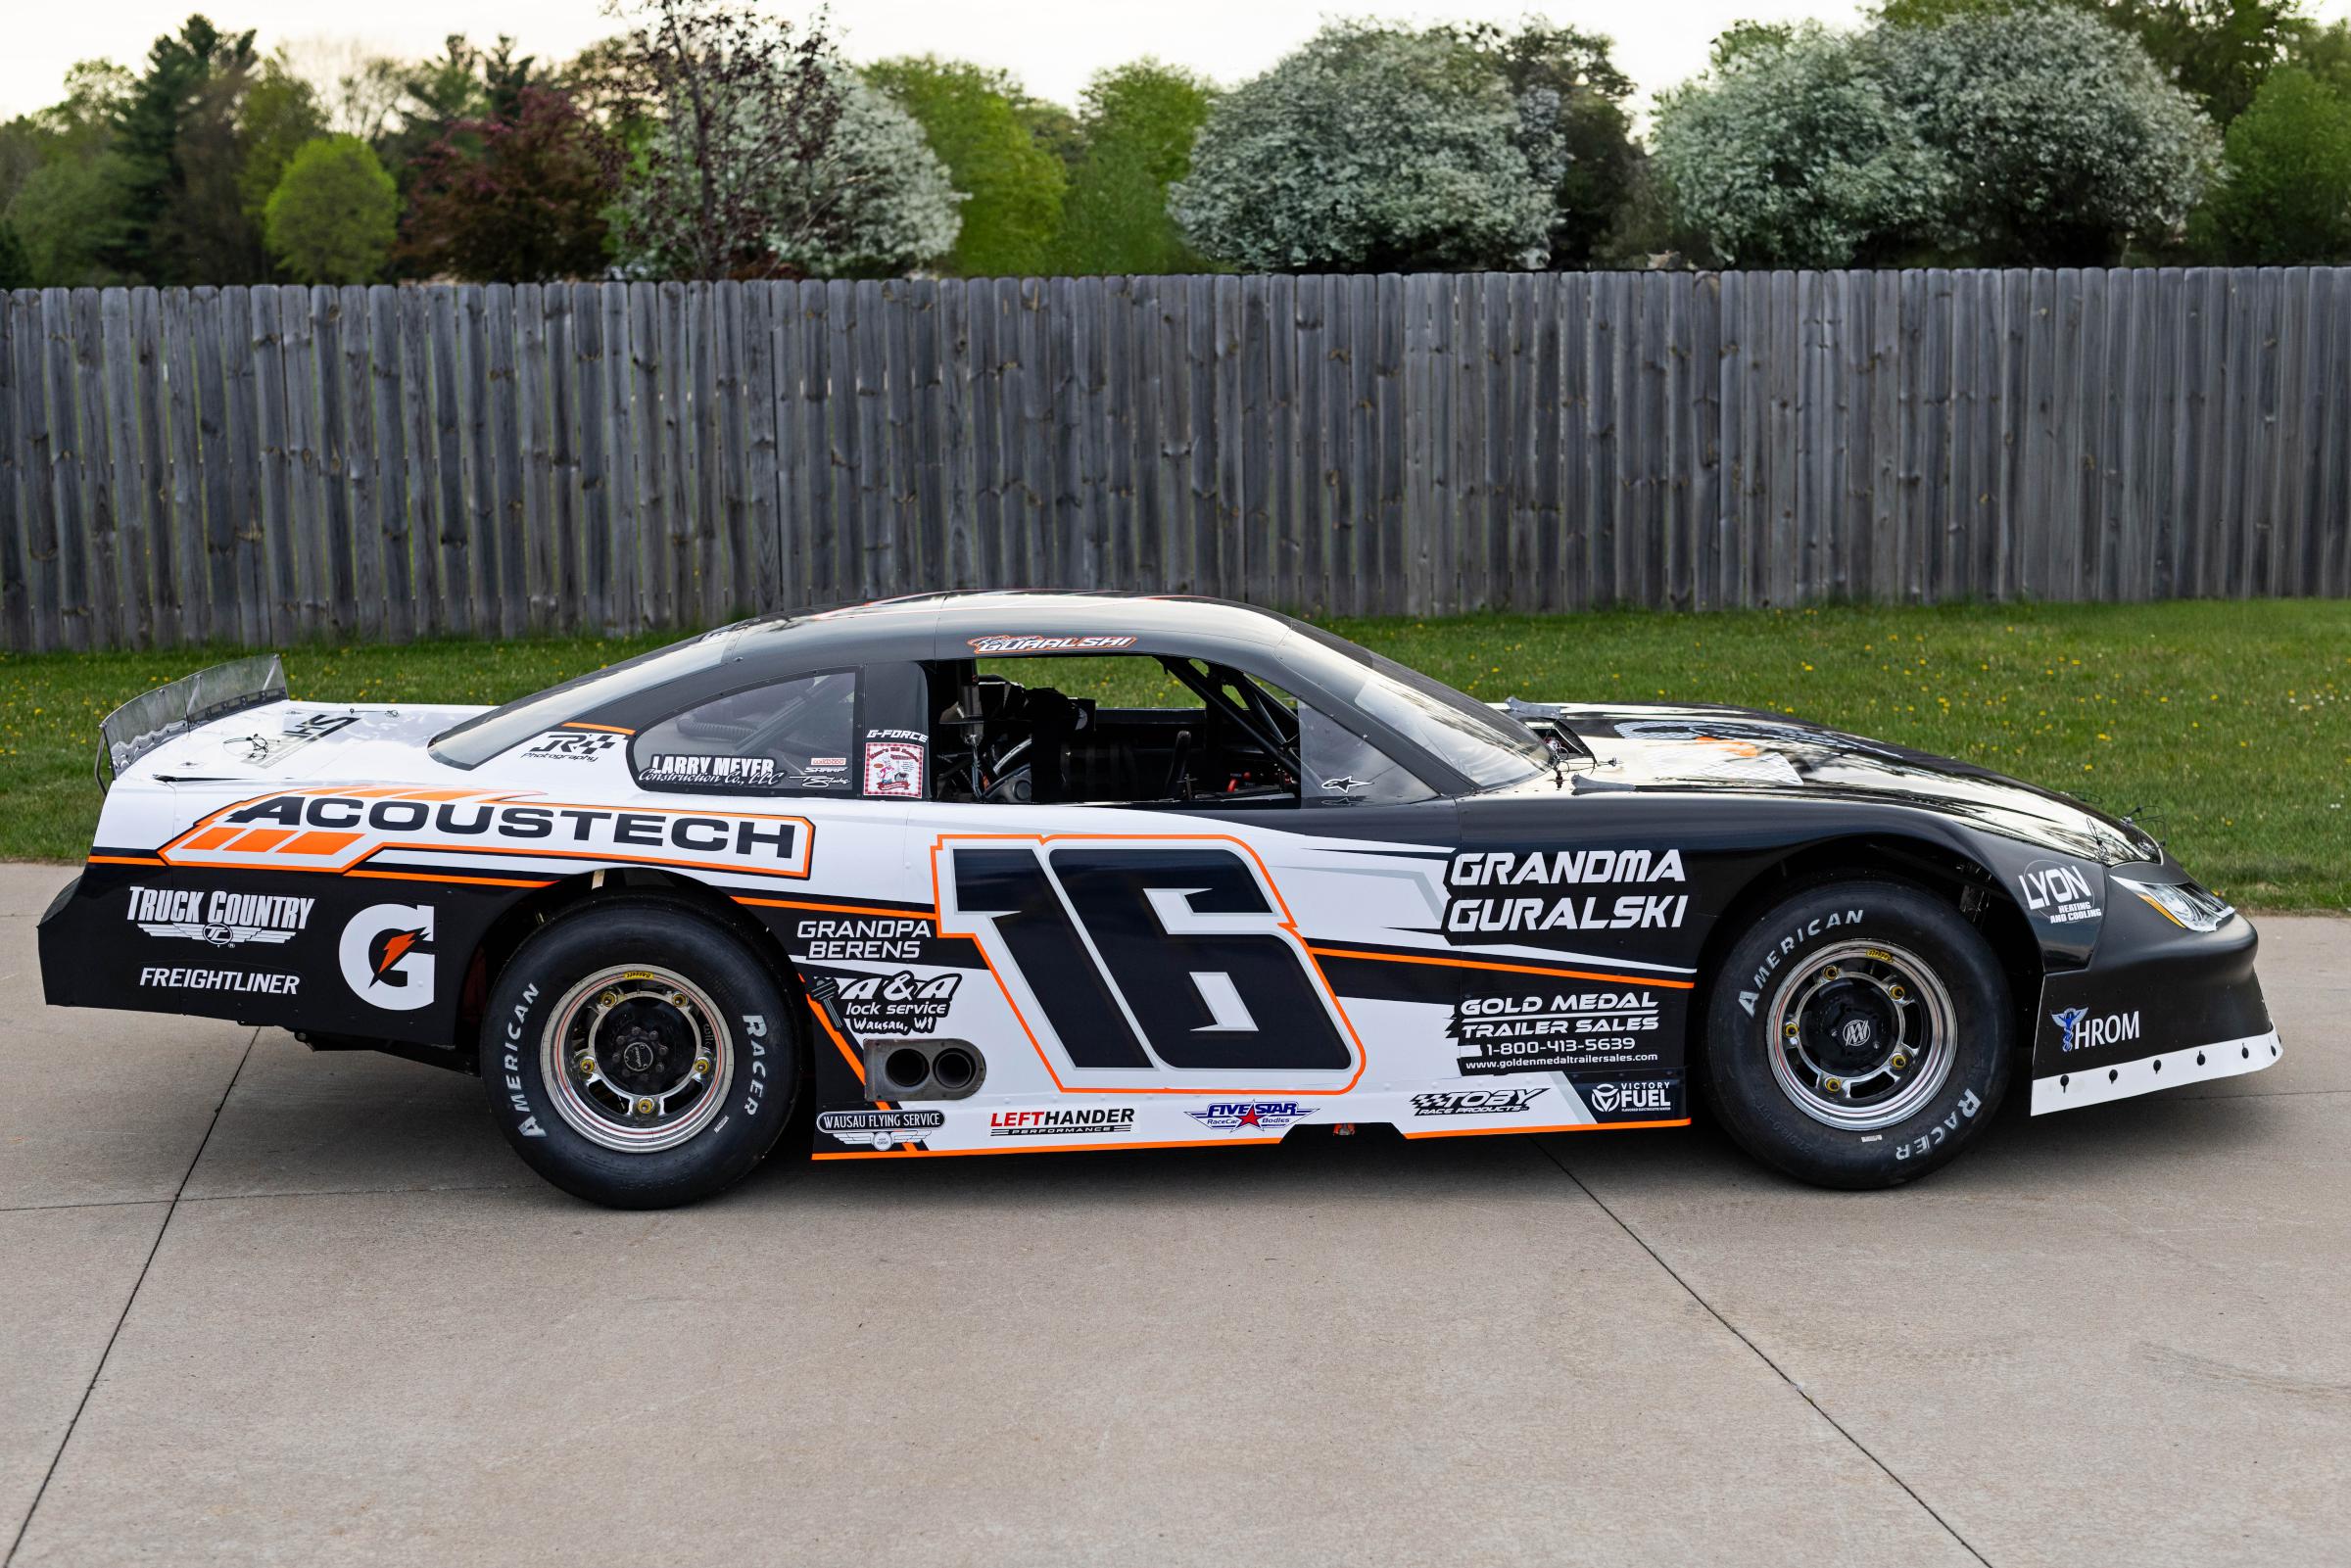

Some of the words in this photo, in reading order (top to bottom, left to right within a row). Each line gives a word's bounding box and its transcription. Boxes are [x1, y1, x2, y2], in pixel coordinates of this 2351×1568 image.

[866, 729, 929, 742] G-FORCE
[520, 752, 599, 762] Photography
[652, 755, 711, 775] LARRY
[713, 757, 774, 778] MEYER
[639, 768, 721, 783] Construction
[748, 772, 784, 785] LLC
[225, 796, 794, 859] ACOUSTECH
[1450, 849, 1686, 885] GRANDMA
[2019, 866, 2091, 910] LYON
[126, 886, 206, 924] TRUCK
[207, 890, 314, 929] COUNTRY
[1448, 895, 1688, 931] GURALSKI
[2050, 915, 2067, 924] AND
[2068, 908, 2102, 922] COOLING
[2058, 901, 2091, 914] HEATING
[797, 920, 932, 938] GRANDPA
[339, 903, 435, 1011] G
[808, 941, 921, 959] BERENS
[951, 847, 1352, 1069] 16
[1738, 910, 1863, 1018] AMERICAN
[139, 967, 301, 995] FREIGHTLINER
[845, 1002, 882, 1016] lock
[886, 1001, 947, 1015] service
[1460, 996, 1542, 1016] GOLD
[1551, 992, 1658, 1011] MEDAL
[853, 1018, 908, 1031] Wausau,
[1462, 1022, 1567, 1038] TRAILER
[1575, 1018, 1659, 1033] SALES
[1487, 1037, 1636, 1056] 1-800-413-5639
[504, 982, 547, 1137] AMERICAN
[742, 1015, 768, 1116] RACER
[1465, 1052, 1658, 1069] www.goldenmedaltrailersales.com
[1620, 1081, 1670, 1090] VICTORY
[1444, 1088, 1545, 1107] TOBY
[1620, 1089, 1671, 1107] FUEL
[990, 1108, 1134, 1126] LEFTHANDER
[1208, 1103, 1251, 1117] FIVE
[1254, 1102, 1297, 1116] STAR
[824, 1116, 866, 1128] WAUSAU
[869, 1115, 900, 1127] FLYING
[903, 1113, 940, 1126] SERVICE
[1895, 1088, 1982, 1161] RACER
